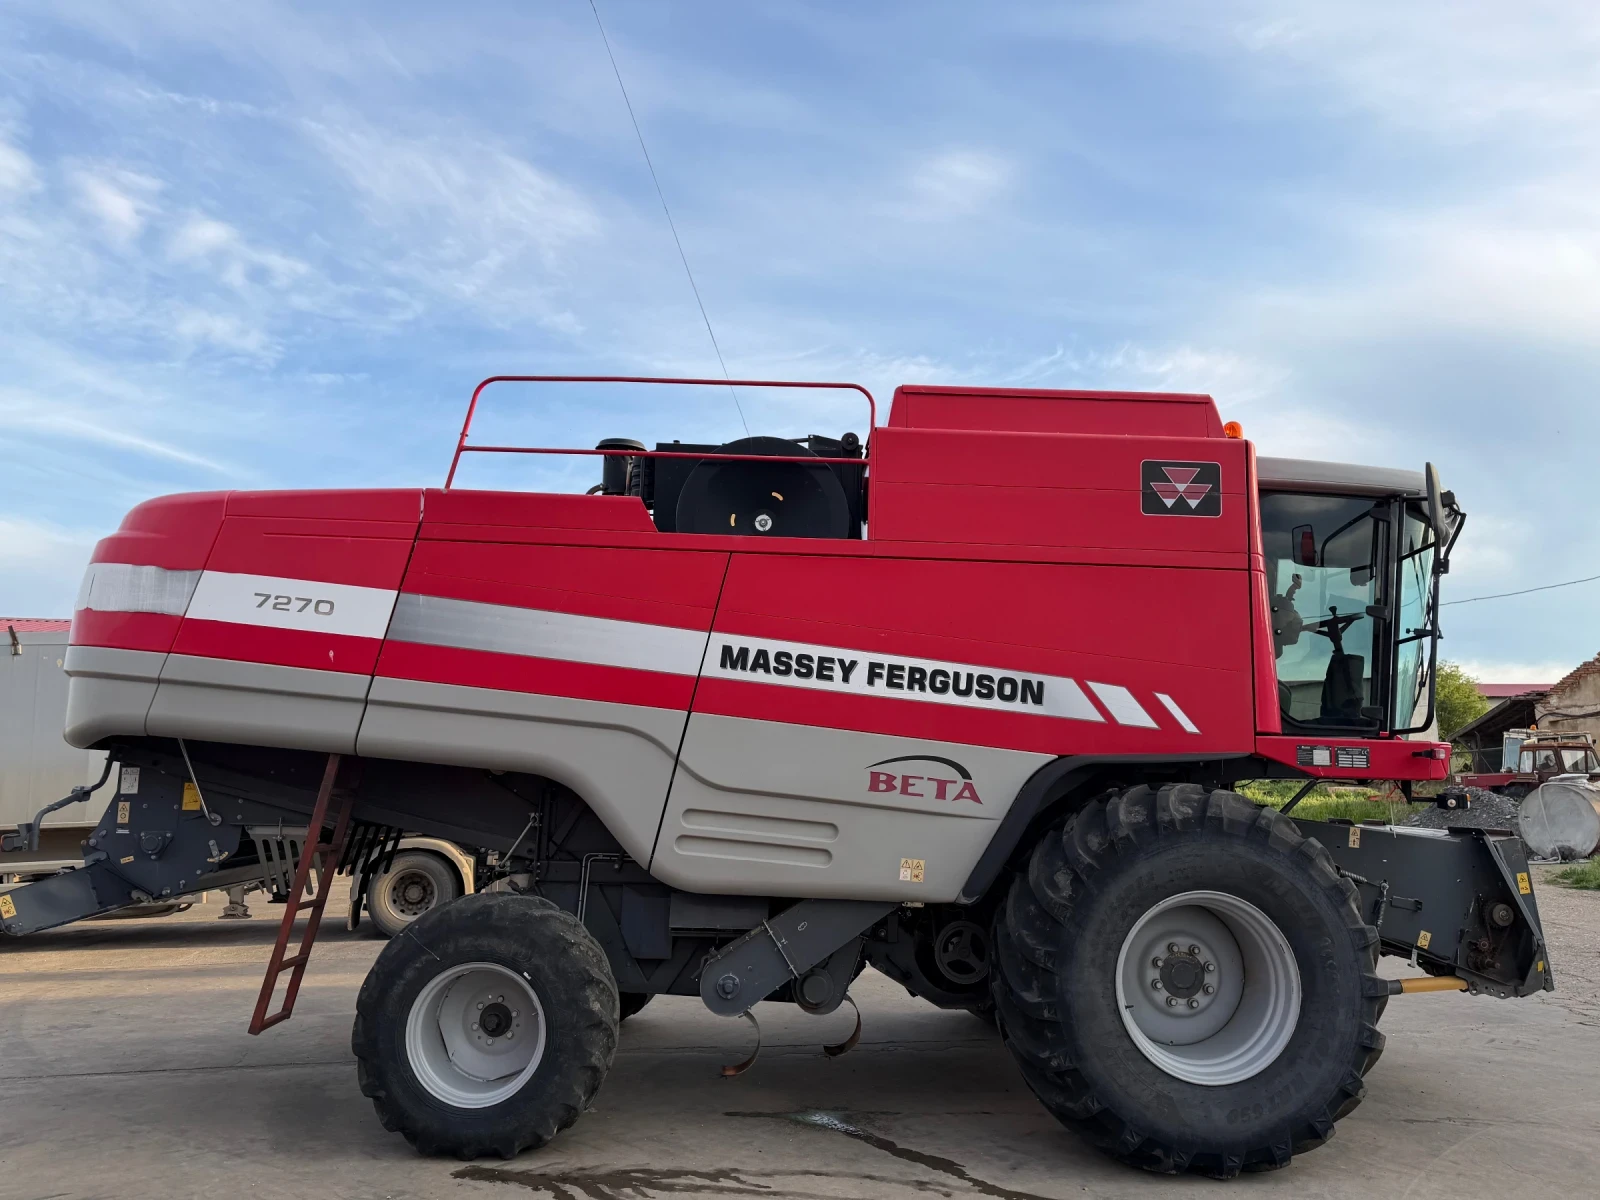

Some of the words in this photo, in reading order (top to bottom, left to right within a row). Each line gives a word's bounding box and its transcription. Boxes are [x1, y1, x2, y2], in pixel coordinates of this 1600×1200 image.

[254, 592, 335, 616] 7270
[720, 644, 858, 683] MASSEY
[867, 661, 1044, 705] FERGUSON
[868, 771, 983, 805] BETA
